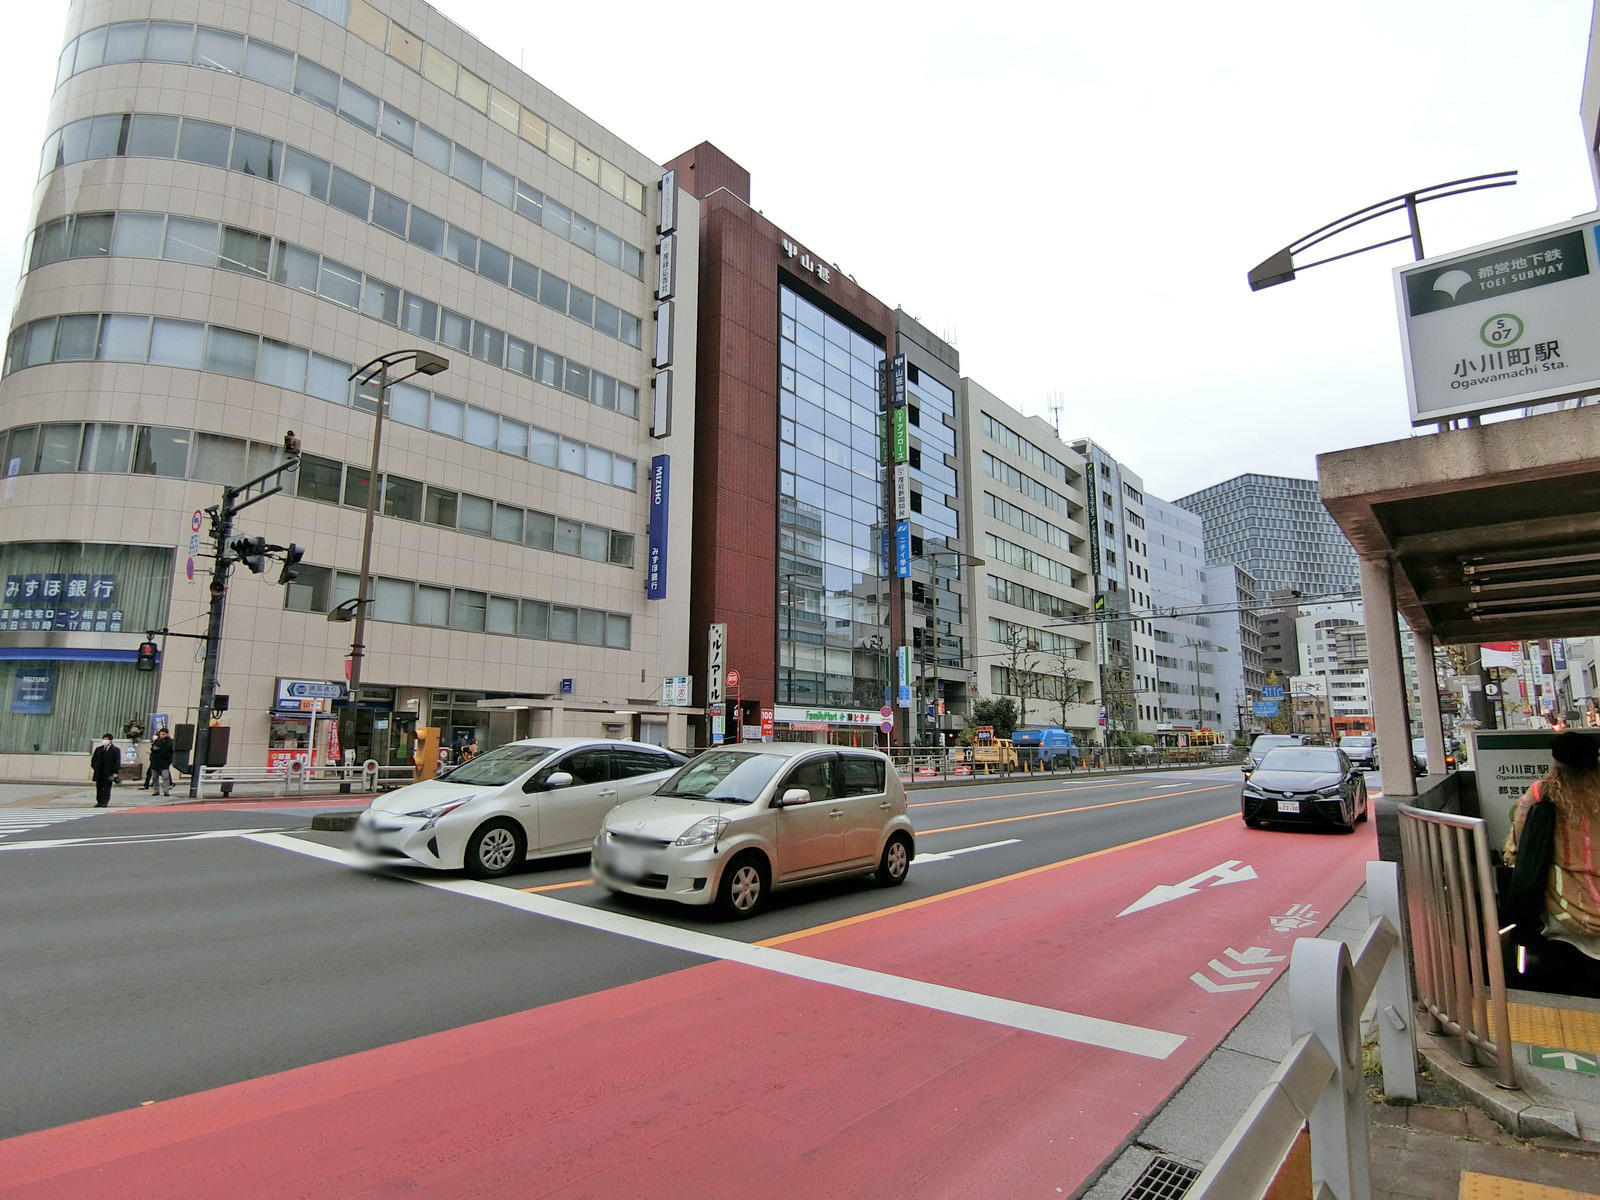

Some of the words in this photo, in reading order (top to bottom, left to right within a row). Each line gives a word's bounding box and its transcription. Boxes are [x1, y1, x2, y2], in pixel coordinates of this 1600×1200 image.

[1477, 248, 1563, 280] 都営地下鉄
[1479, 277, 1507, 291] TOEI
[1511, 262, 1564, 283] SUBWAY
[1491, 328, 1512, 342] 07
[1496, 319, 1505, 329] S
[1453, 339, 1561, 378] 小川町駅
[1450, 364, 1538, 390] Ogawamachi
[1542, 360, 1569, 372] Sta.
[654, 466, 663, 505] MIZUHO
[650, 547, 660, 590] みずほ銀行
[6, 579, 114, 598] みずほ銀行
[710, 639, 722, 701] ルノアール
[761, 711, 773, 720] 100
[806, 710, 837, 722] FamilyMart
[1498, 764, 1550, 775] 小川町駅
